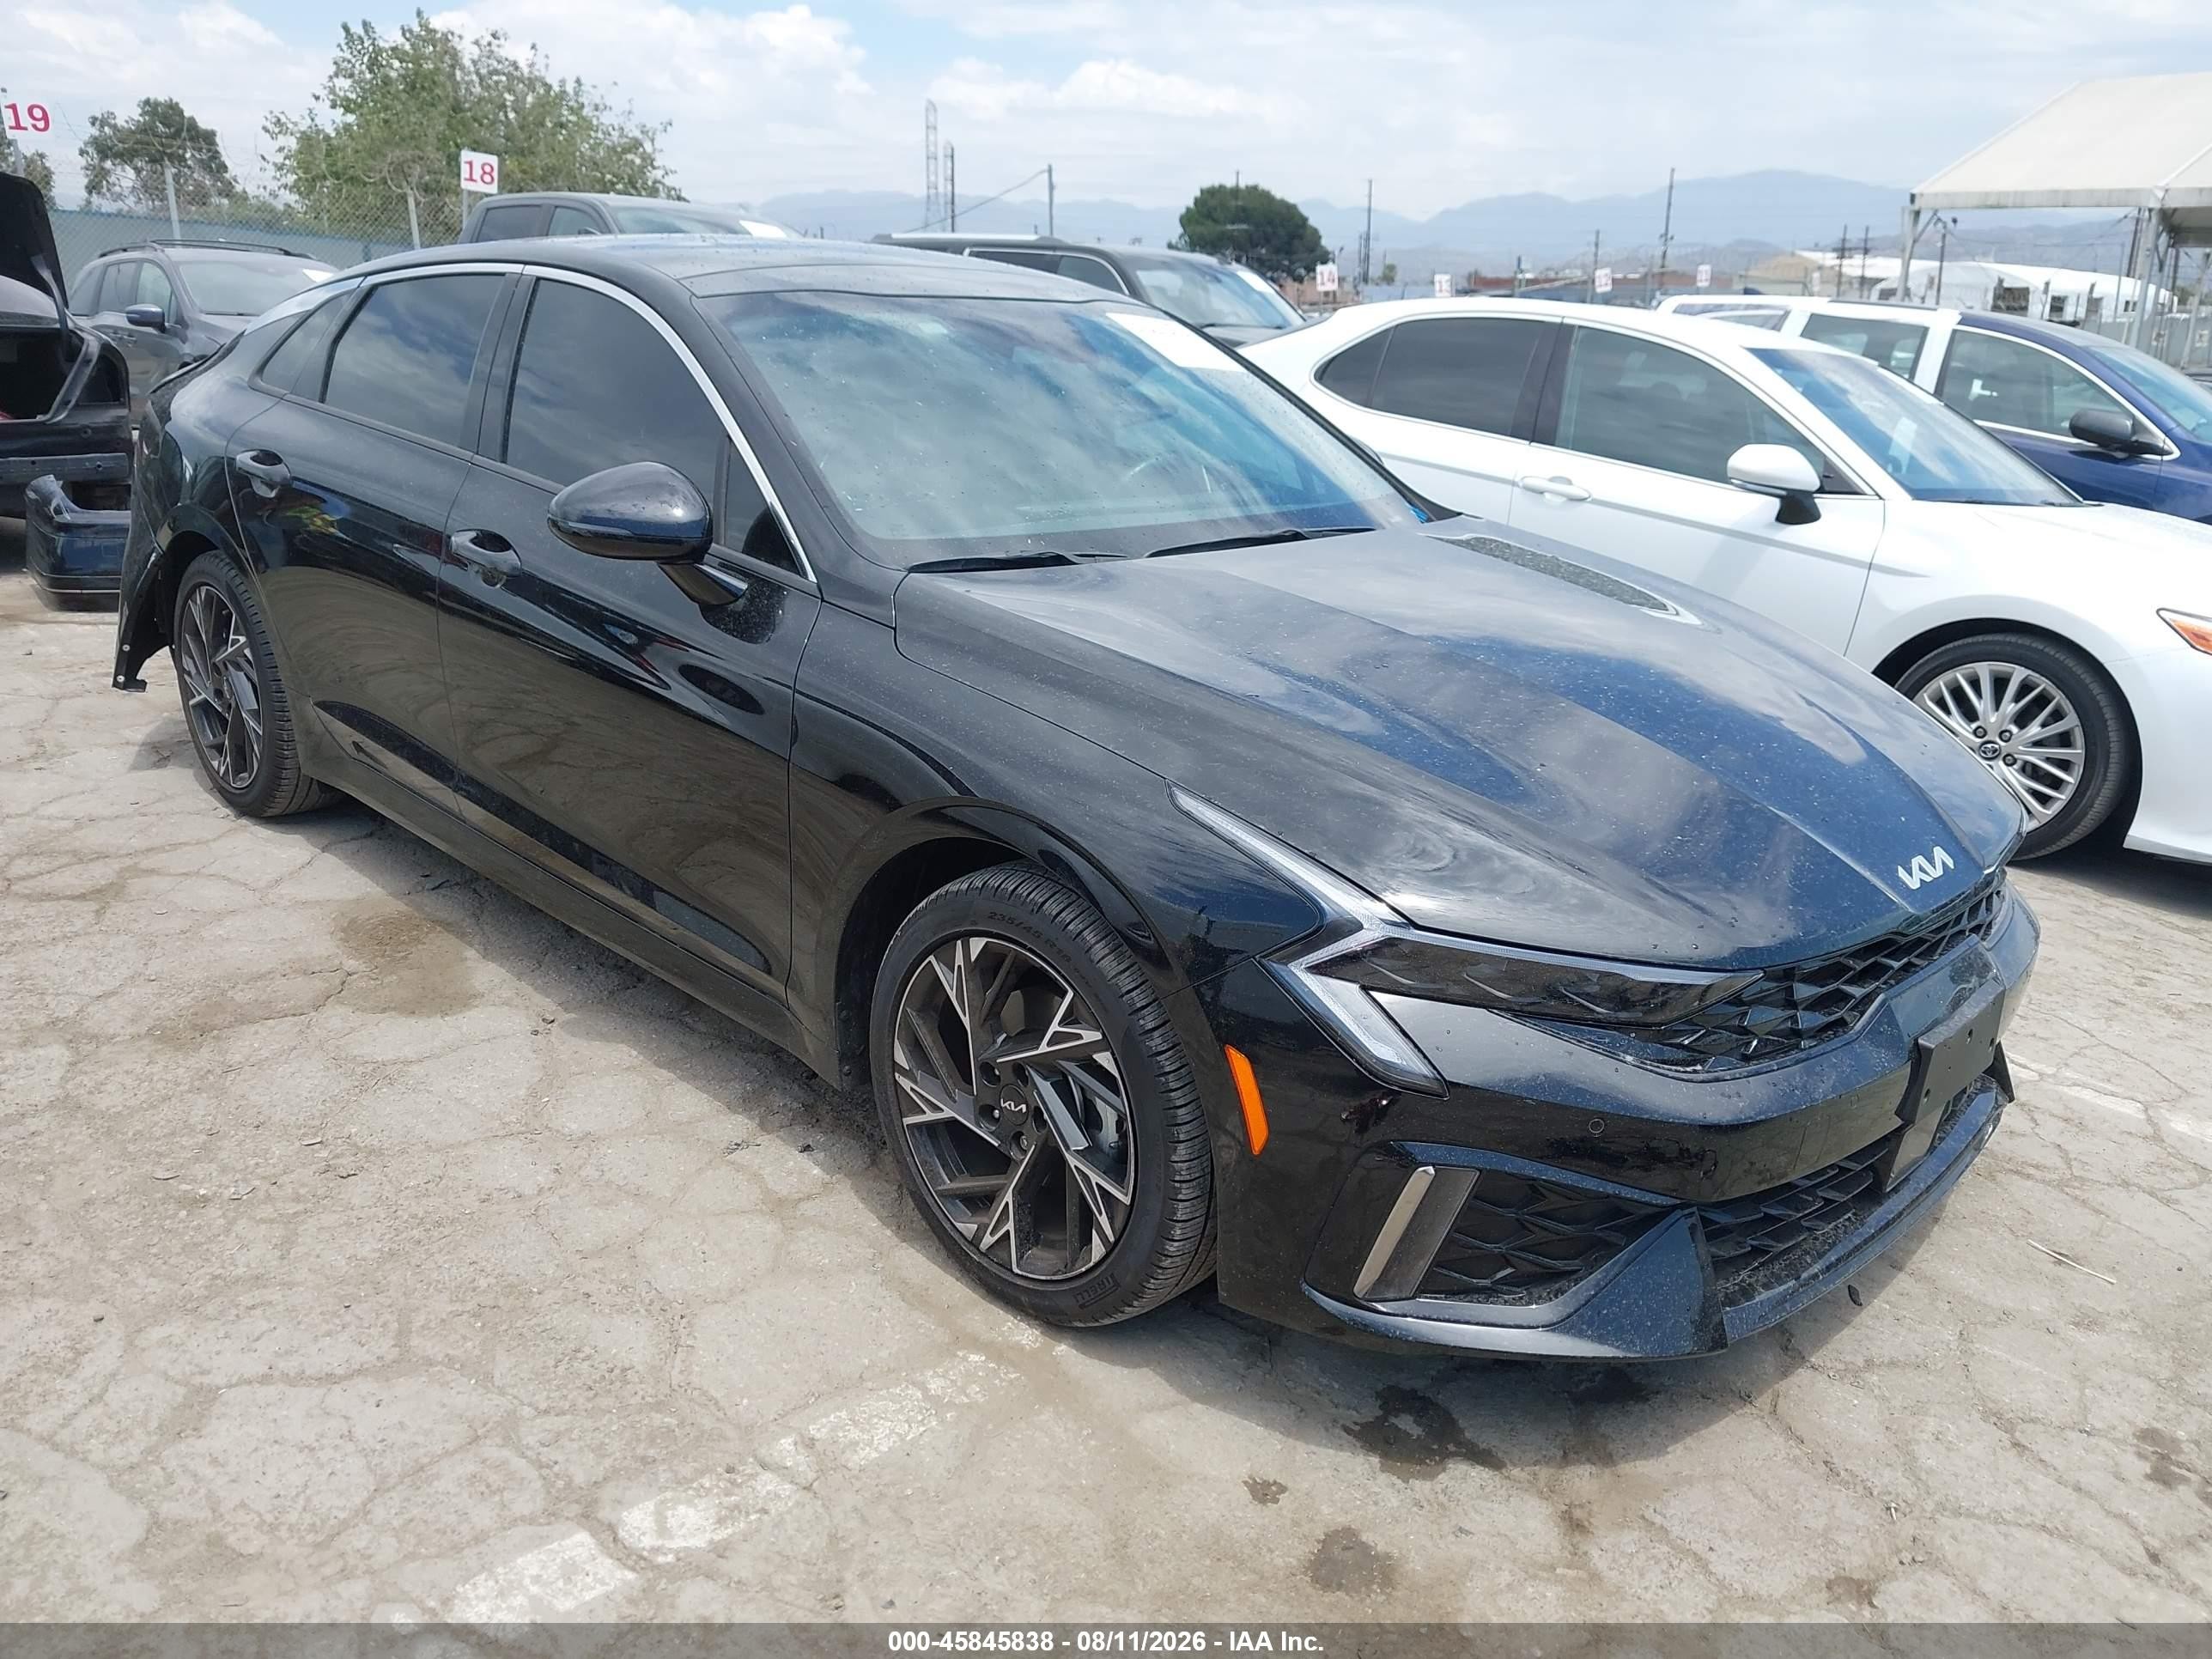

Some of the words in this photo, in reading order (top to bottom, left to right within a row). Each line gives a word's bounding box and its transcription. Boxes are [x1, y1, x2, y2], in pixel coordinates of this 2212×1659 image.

[4, 103, 50, 132] 19
[464, 160, 495, 185] 18
[1319, 270, 1335, 286] 14
[1898, 846, 1954, 890] KIA
[988, 911, 1042, 939] 235/45
[1000, 1098, 1027, 1114] KIA
[1073, 1273, 1121, 1310] PIRELLI
